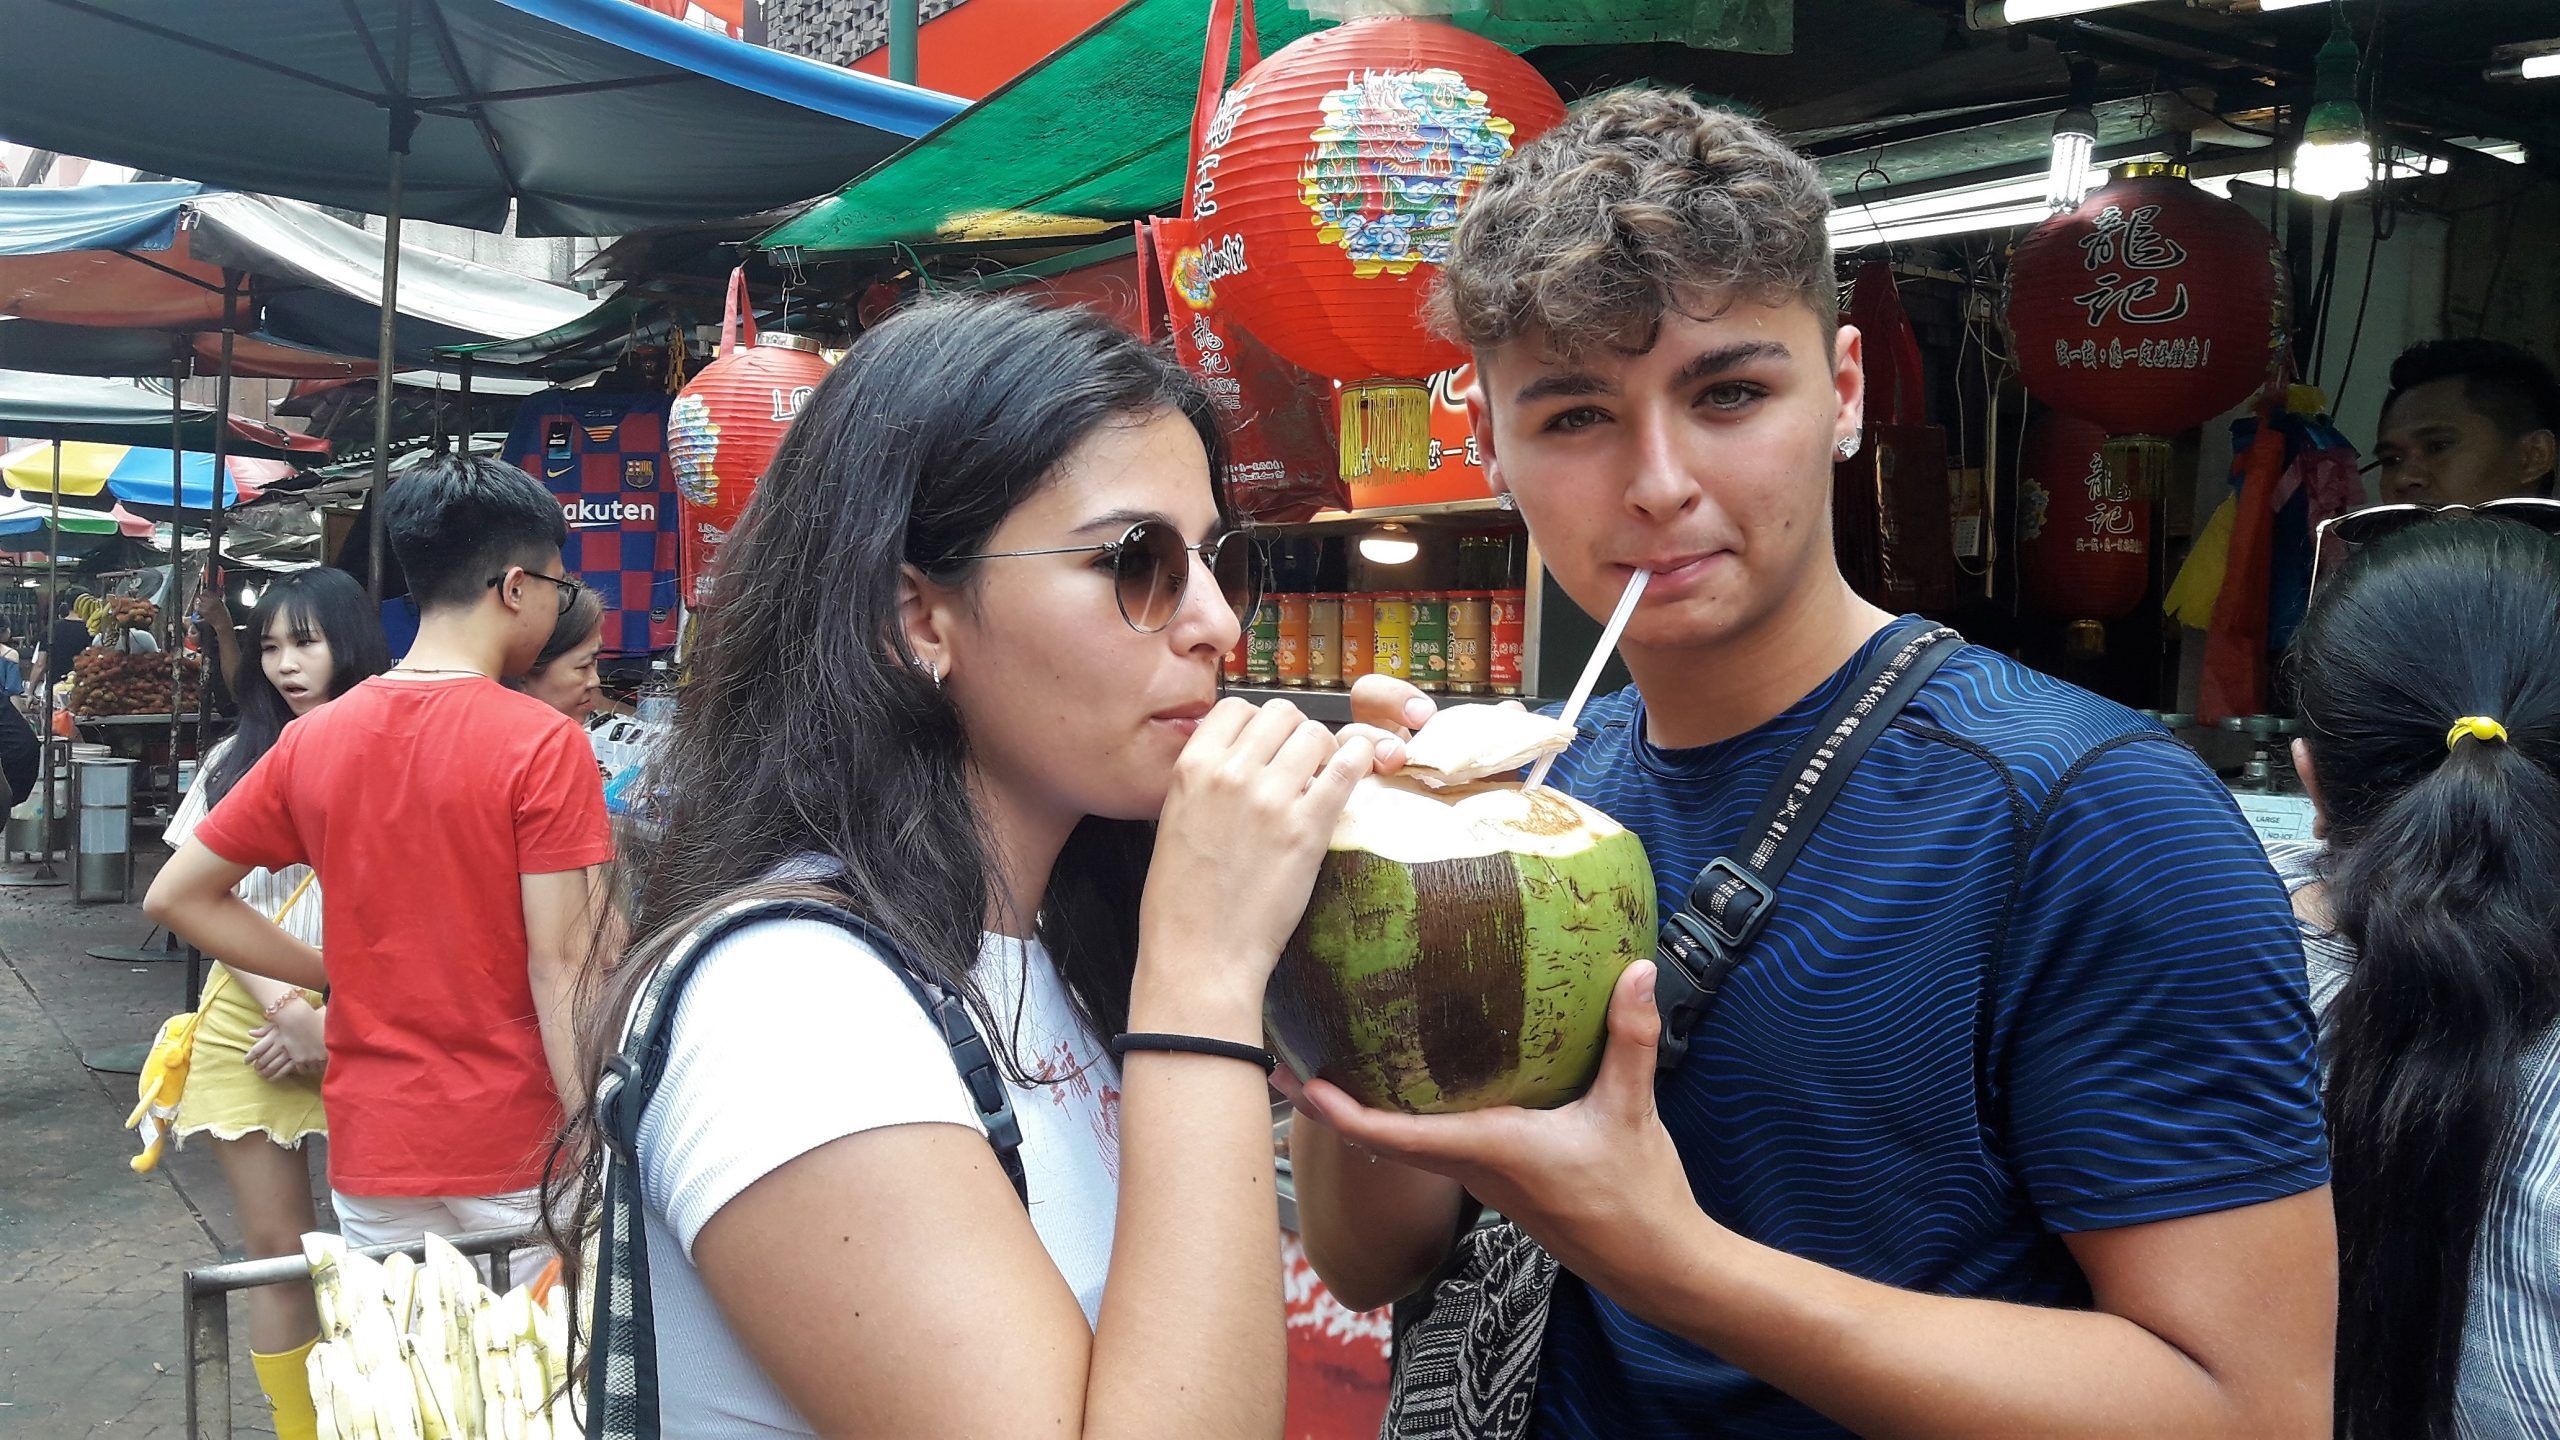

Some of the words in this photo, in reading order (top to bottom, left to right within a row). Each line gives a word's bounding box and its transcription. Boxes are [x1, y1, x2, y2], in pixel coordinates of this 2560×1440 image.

[2073, 203, 2189, 328] 龍記
[1192, 312, 1231, 374] 龍記
[562, 498, 655, 521] akuten
[2255, 815, 2281, 824] LARGE
